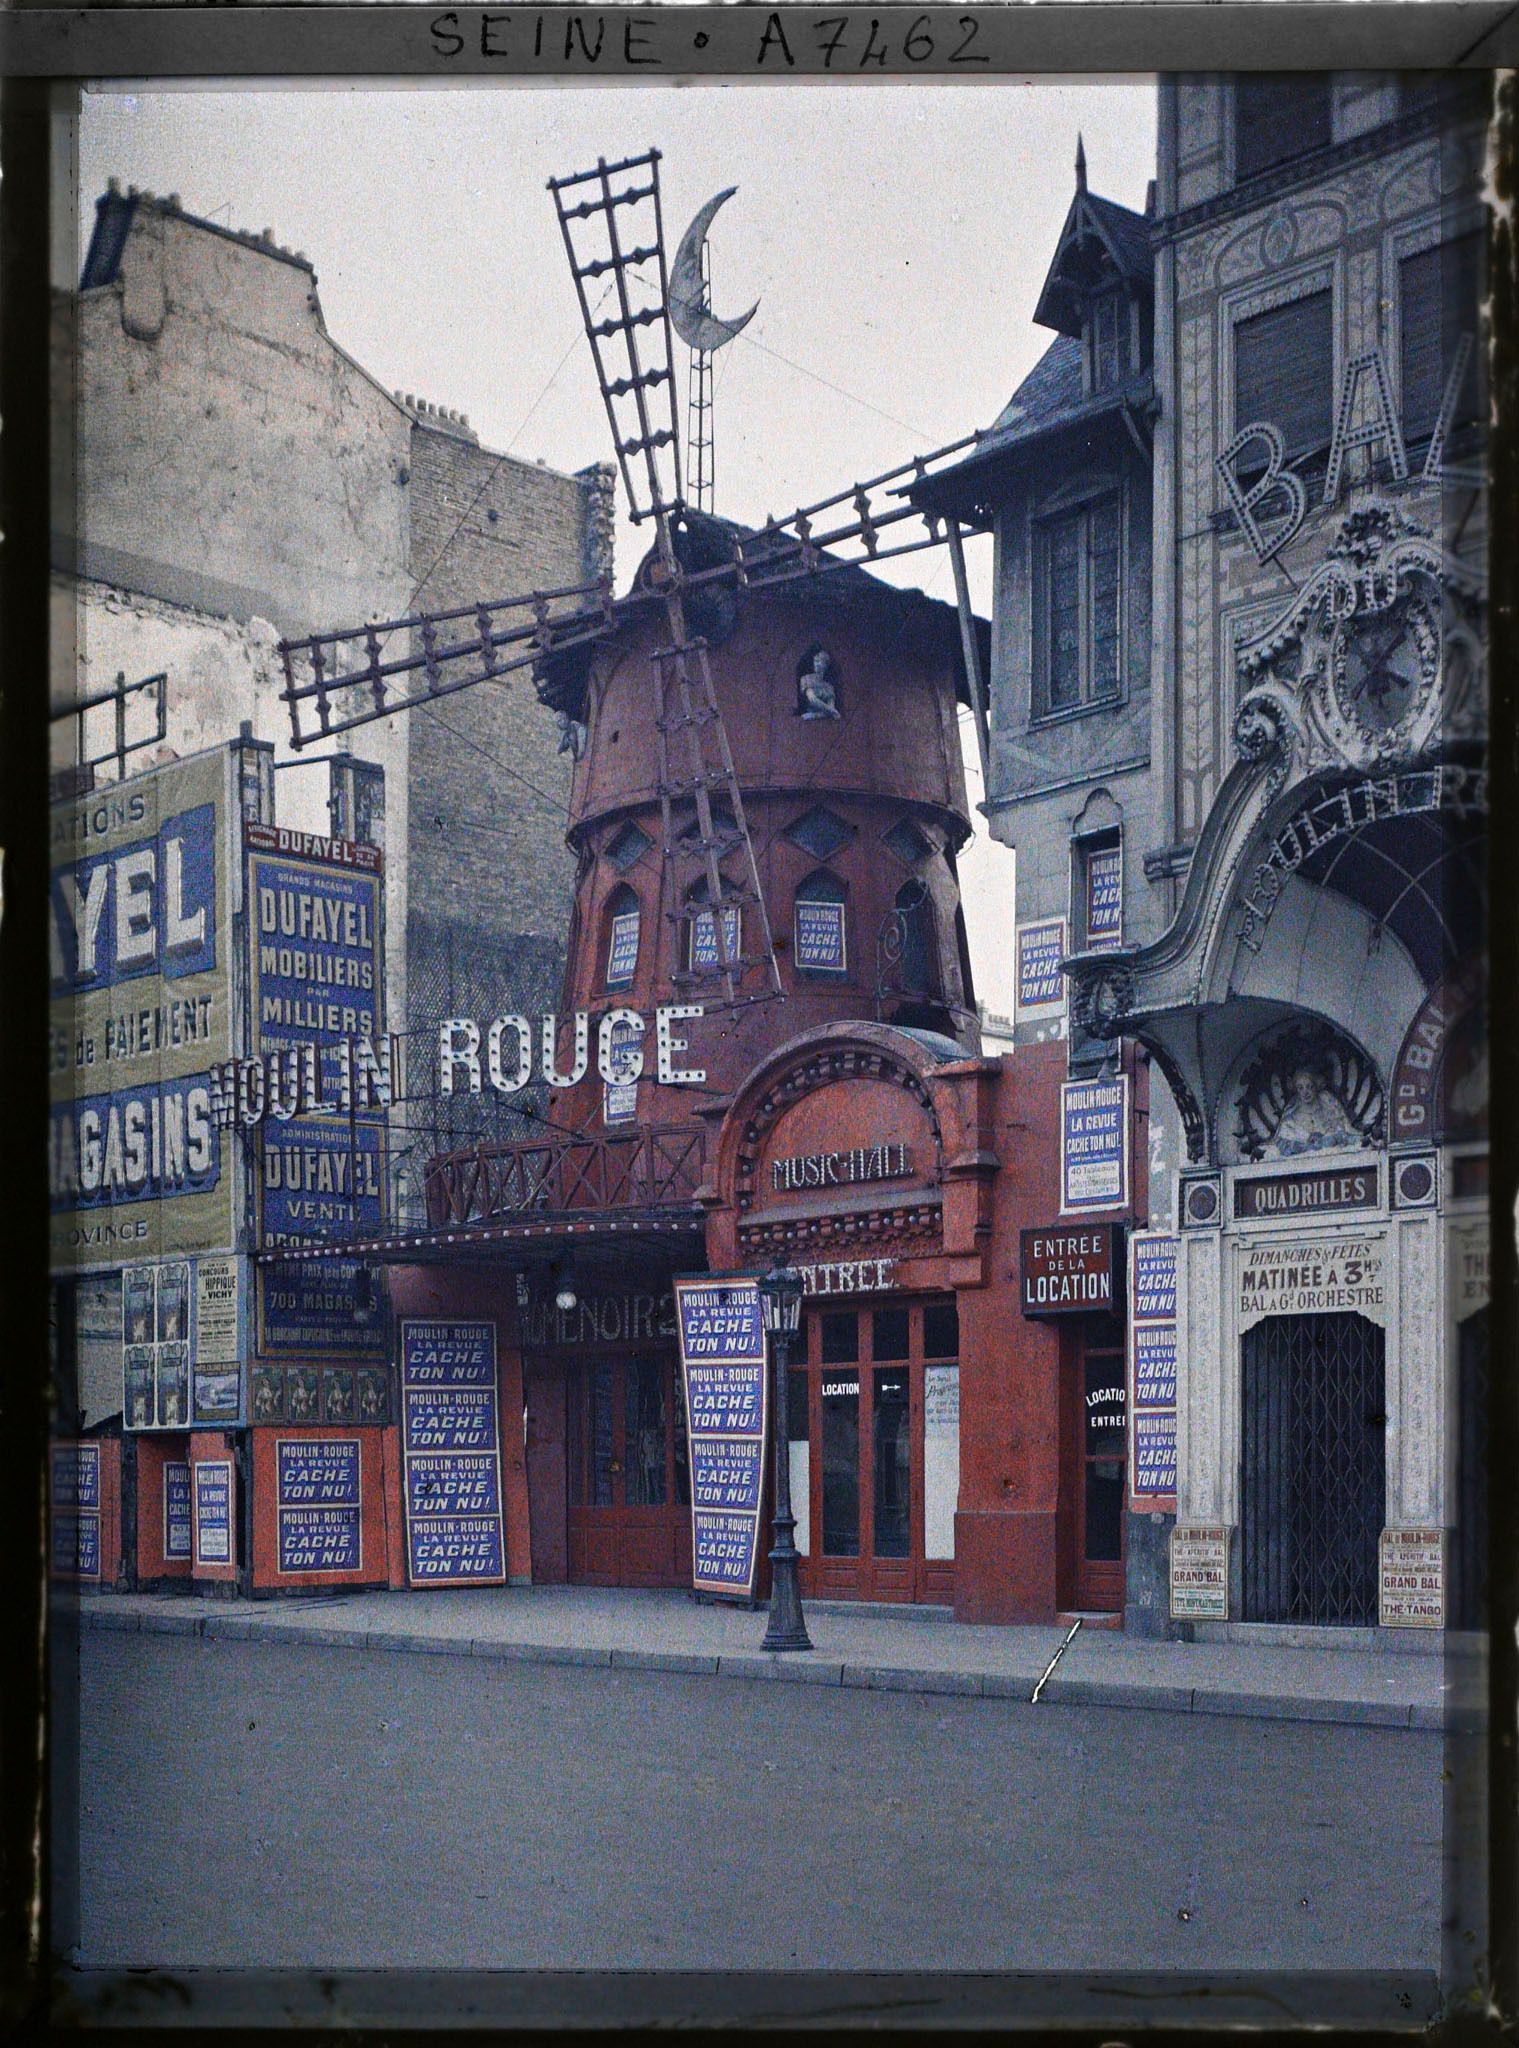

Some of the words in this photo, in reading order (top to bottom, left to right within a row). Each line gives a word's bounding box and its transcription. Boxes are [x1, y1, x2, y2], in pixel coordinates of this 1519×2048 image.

[429, 15, 662, 64] SEINE
[756, 13, 991, 65] A7462
[279, 829, 353, 862] DUFAYEL
[260, 887, 373, 949] DUFAYEL
[261, 945, 373, 990] MOBILIERS
[263, 996, 373, 1035] MILLIERS
[75, 1030, 94, 1066] de
[105, 994, 213, 1061] PAIEMENT
[210, 1031, 397, 1129] MOULIN
[440, 1005, 707, 1096] ROUGE
[1071, 1117, 1083, 1132] LA
[1085, 1112, 1117, 1130] REVUE
[49, 1087, 211, 1194] AGASINS
[1067, 1136, 1089, 1154] CACHE
[772, 1143, 914, 1190] MUSIC-HALL
[1254, 1177, 1367, 1213] QUADRILLES
[56, 1219, 147, 1246] OVINCE
[1249, 1247, 1322, 1266] DIMANCHES
[1048, 1260, 1065, 1271] DE
[1069, 1259, 1086, 1270] LA
[1139, 1261, 1148, 1271] LA
[1150, 1260, 1176, 1271] REVU
[786, 1257, 900, 1296] NTREE
[1242, 1263, 1322, 1292] MATINÉE
[1344, 1260, 1364, 1285] 3
[208, 1289, 233, 1299] VICHY
[1026, 1272, 1110, 1304] LOCATION
[1137, 1295, 1158, 1312] TON
[1240, 1294, 1268, 1312] BAL
[1297, 1286, 1384, 1309] ORCHESTRE
[692, 1309, 706, 1318] LA
[710, 1307, 751, 1316] REVUE
[687, 1319, 753, 1334] CACHE
[417, 1341, 433, 1349] LA
[437, 1341, 482, 1349] REVUE
[687, 1338, 719, 1353] TON
[409, 1351, 484, 1363] CACHE
[1139, 1350, 1148, 1359] LA
[1150, 1349, 1176, 1359] REVU
[409, 1367, 444, 1379] TON
[697, 1384, 711, 1393] LA
[714, 1383, 753, 1393] REVUE
[822, 1382, 860, 1397] LOCATION
[1137, 1383, 1157, 1399] TON
[693, 1395, 755, 1410] CACHE
[1085, 1387, 1126, 1408] LOCATIO
[418, 1406, 434, 1414] LA
[438, 1406, 484, 1414] REVUE
[411, 1416, 486, 1429] CACHE
[693, 1413, 721, 1427] TON
[410, 1432, 446, 1444] TON
[1139, 1436, 1148, 1446] LA
[1150, 1436, 1176, 1446] REVU
[308, 1459, 348, 1467] REVUE
[702, 1458, 714, 1467] LA
[717, 1458, 752, 1468] REVUE
[284, 1469, 350, 1482] CACHE
[420, 1472, 436, 1480] LA
[440, 1471, 486, 1480] REVUE
[697, 1469, 752, 1485] CACHE
[1137, 1470, 1158, 1487] TON
[284, 1485, 315, 1498] TON
[413, 1481, 488, 1495] CACHE
[696, 1486, 722, 1501] TON
[413, 1497, 449, 1511] TON
[291, 1526, 305, 1534] LA
[309, 1525, 350, 1534] REVUE
[702, 1531, 714, 1540] LA
[716, 1532, 746, 1542] REVUE
[285, 1535, 351, 1549] CACHE
[423, 1535, 439, 1543] LA
[443, 1534, 489, 1542] REVUE
[416, 1543, 491, 1558] CACHE
[698, 1542, 747, 1560] CACHE
[284, 1552, 316, 1565] TON
[416, 1560, 452, 1573] TON
[698, 1560, 720, 1575] TON
[1174, 1571, 1203, 1582] GRAND
[1206, 1571, 1224, 1582] BAL
[1384, 1576, 1417, 1589] GRAND
[1421, 1577, 1440, 1589] BAL
